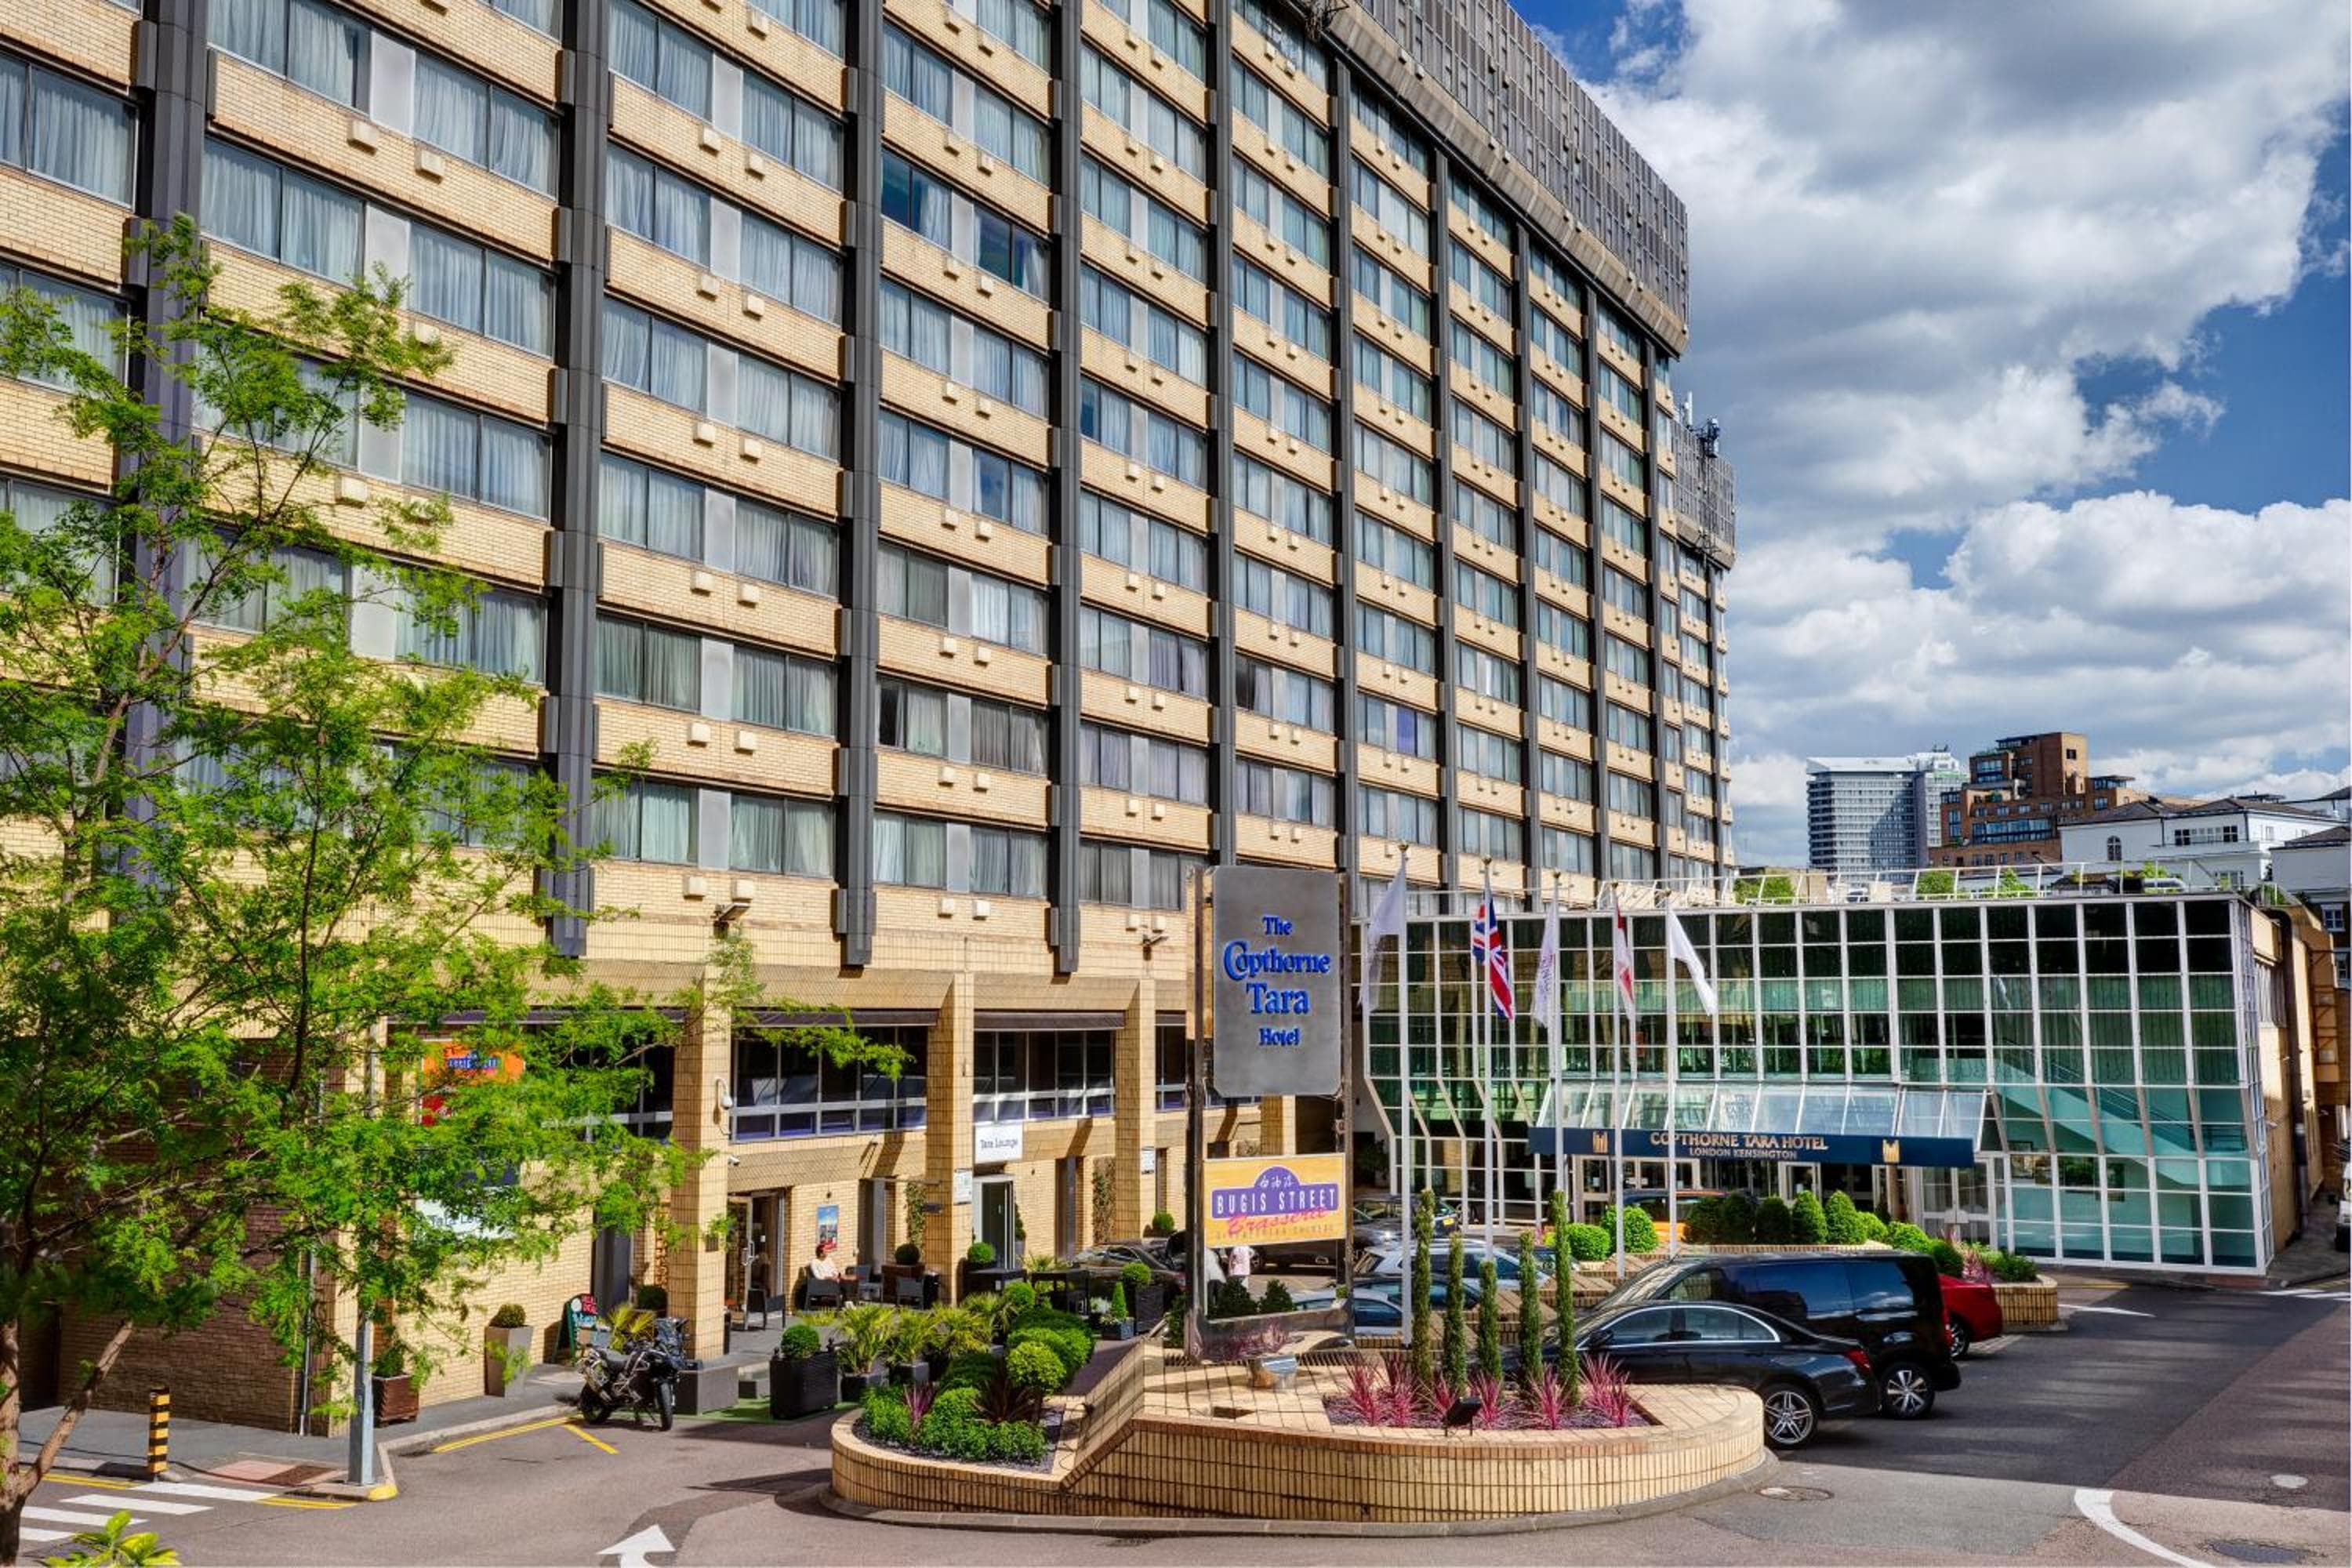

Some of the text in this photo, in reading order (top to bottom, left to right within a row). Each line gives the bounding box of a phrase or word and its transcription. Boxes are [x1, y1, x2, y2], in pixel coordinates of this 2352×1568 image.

[1262, 916, 1293, 935] The
[1223, 939, 1331, 981] Copthorne
[1245, 982, 1310, 1015] Tara
[1258, 1027, 1301, 1047] Hotel
[1740, 1134, 1780, 1149] TARA
[1781, 1136, 1830, 1151] HOTEL
[1689, 1147, 1798, 1160] LONDON KENSINGTON
[1217, 1189, 1335, 1214] BUGIS STREET
